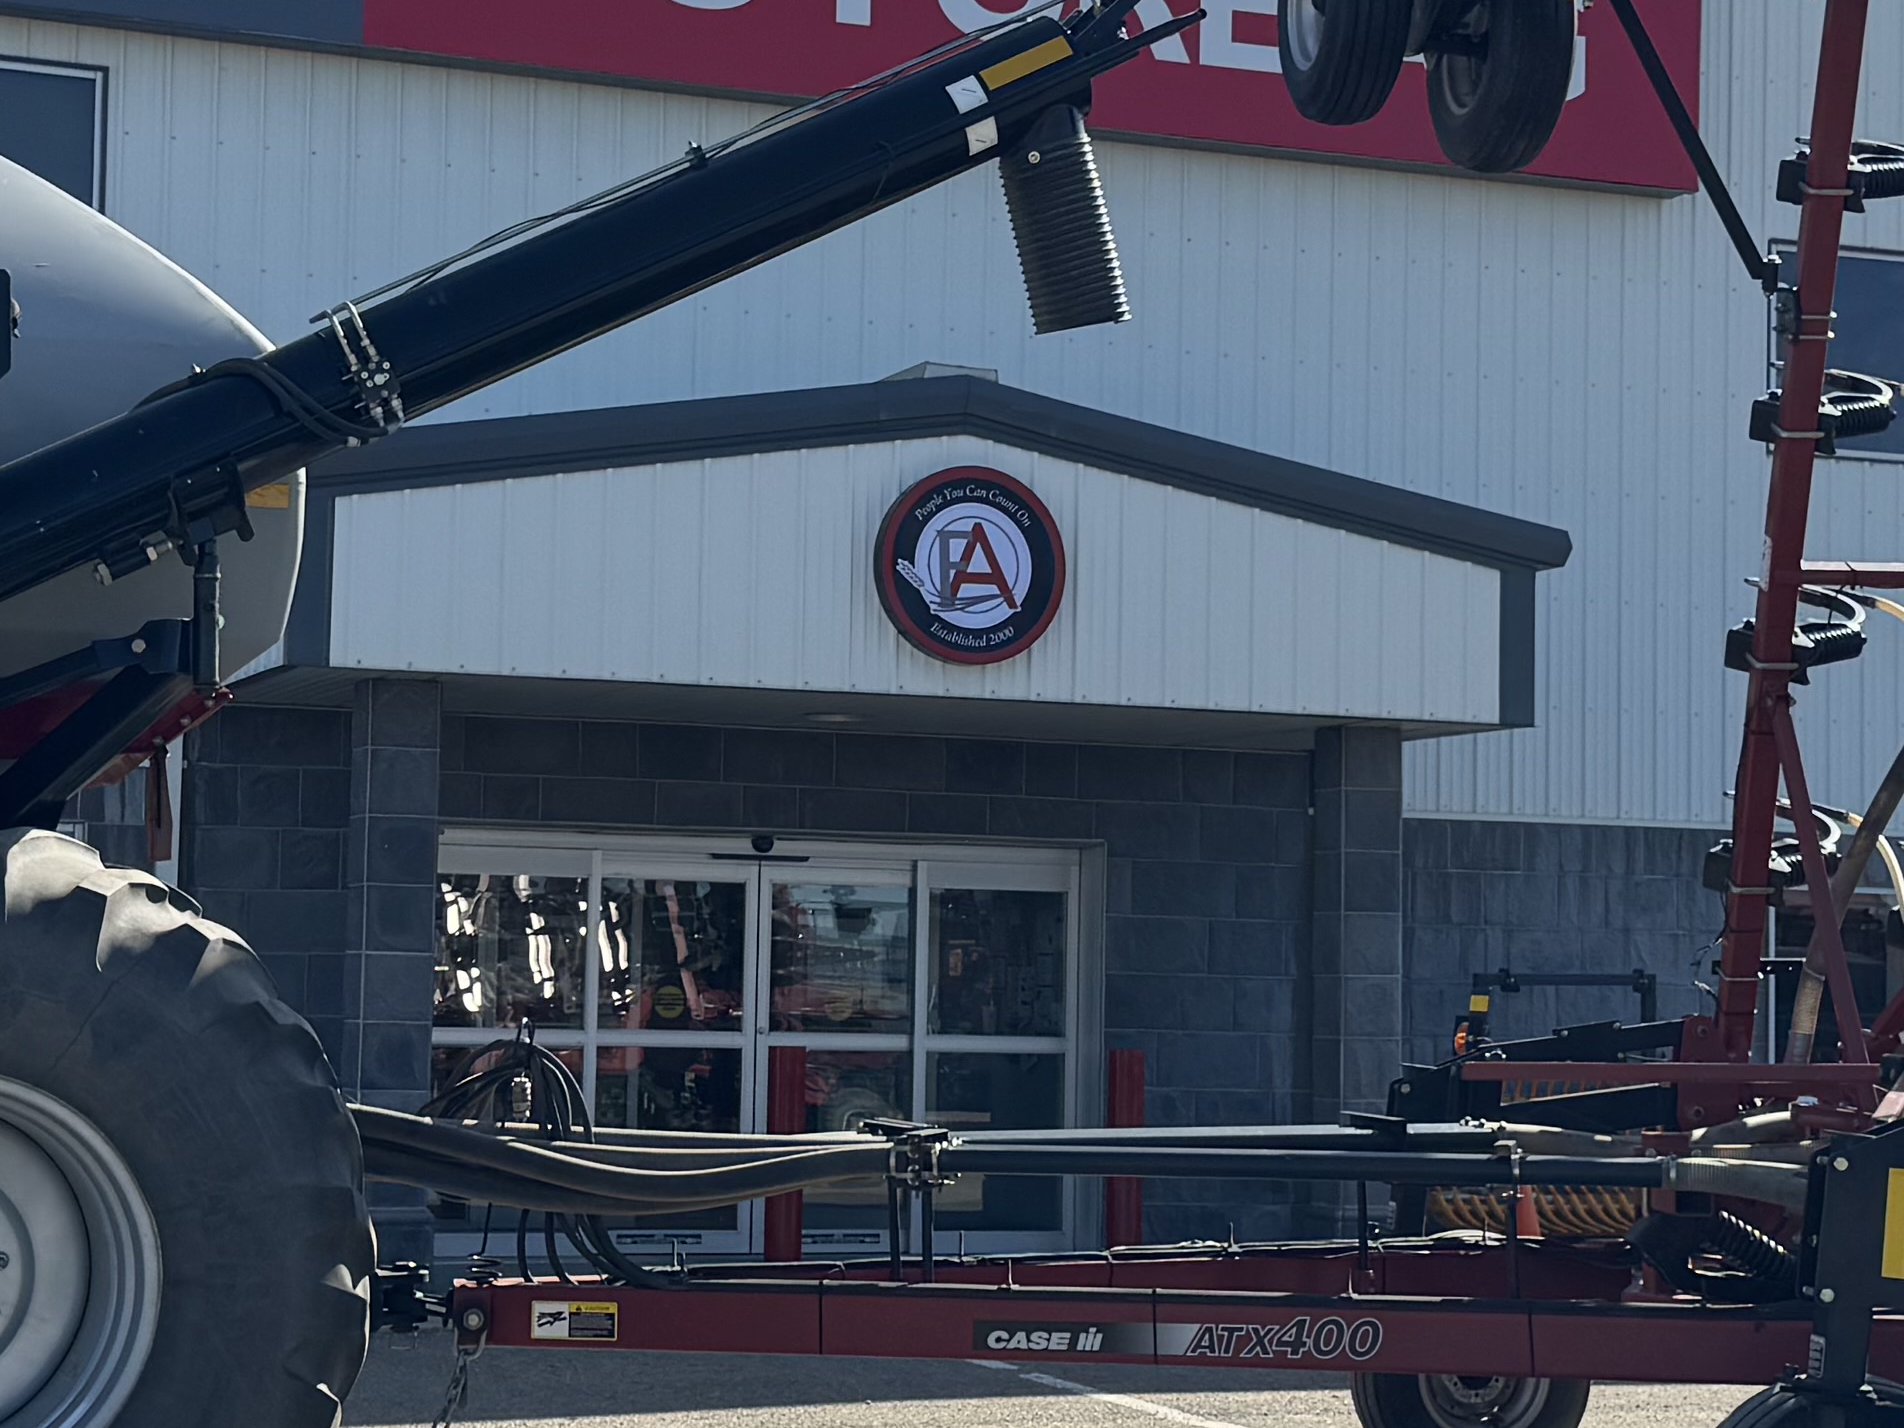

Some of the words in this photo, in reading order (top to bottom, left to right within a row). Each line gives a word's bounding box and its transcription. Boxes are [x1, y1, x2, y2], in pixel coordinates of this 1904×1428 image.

[915, 493, 944, 520] People
[944, 487, 964, 500] You
[966, 485, 987, 497] Can
[989, 490, 1018, 512] Count
[1017, 510, 1031, 527] On
[930, 622, 986, 647] Established
[989, 626, 1014, 645] 2000
[986, 1329, 1072, 1351] CASE
[1185, 1317, 1383, 1360] ATX400
